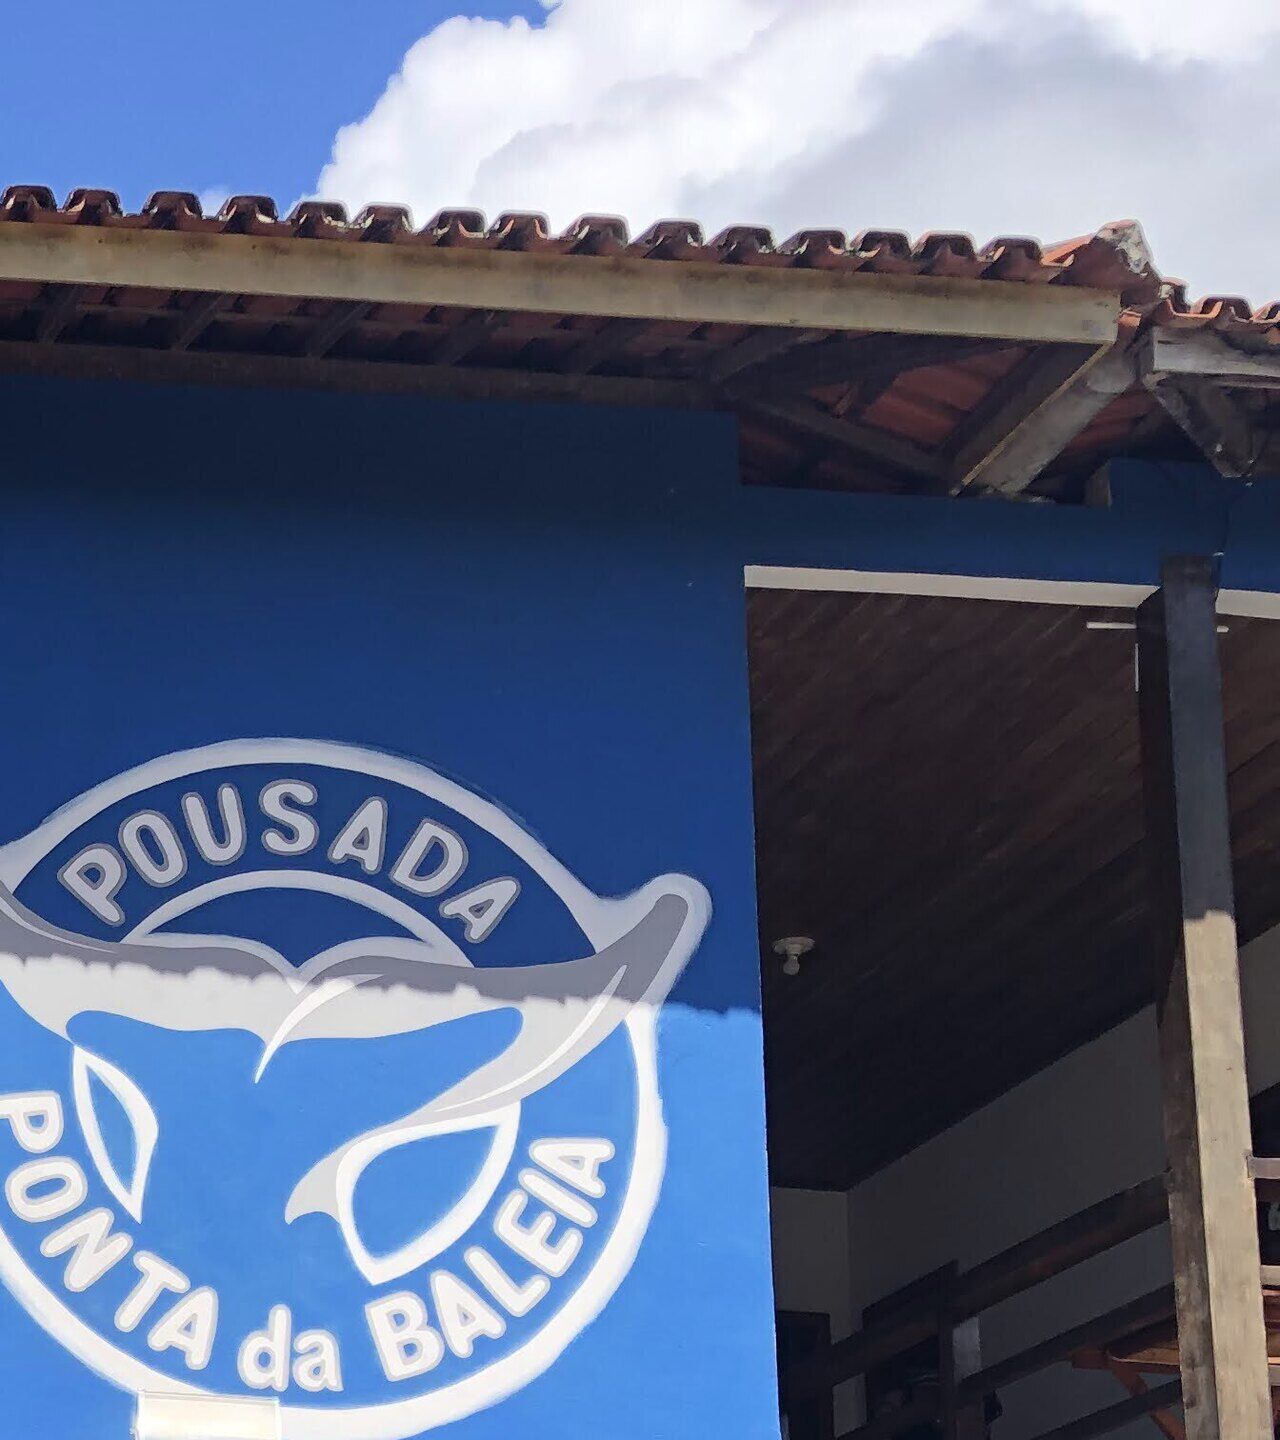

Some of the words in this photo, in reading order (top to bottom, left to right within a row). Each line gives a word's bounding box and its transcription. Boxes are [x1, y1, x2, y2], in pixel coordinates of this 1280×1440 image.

[57, 779, 520, 944] POUSADA
[238, 1305, 344, 1393] da
[364, 1137, 617, 1383] BALEIA
